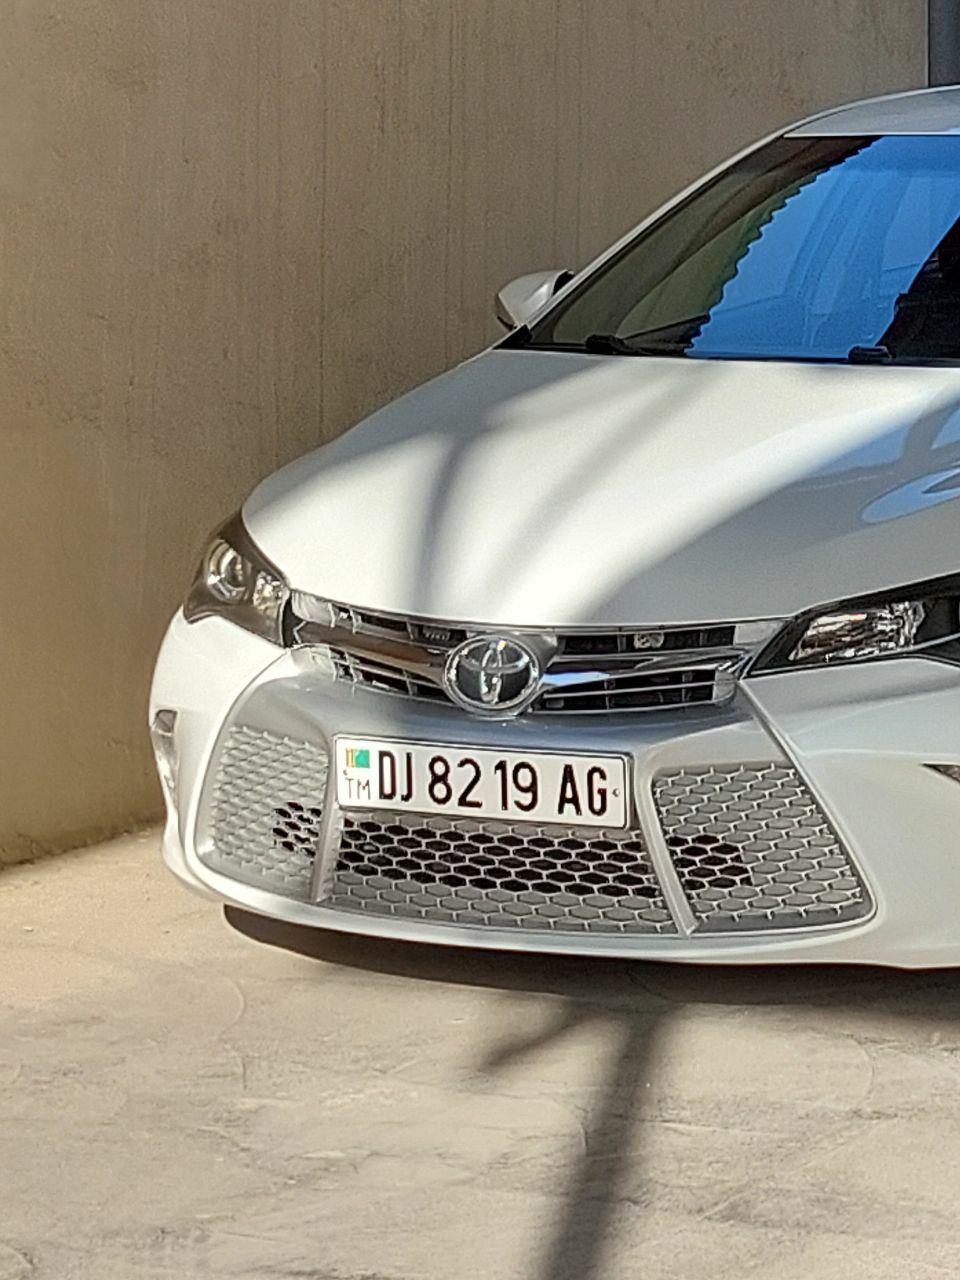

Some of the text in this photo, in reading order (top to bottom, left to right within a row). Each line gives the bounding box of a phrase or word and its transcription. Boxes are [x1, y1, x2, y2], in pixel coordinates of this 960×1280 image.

[345, 777, 371, 800] TM
[378, 750, 608, 817] DJ 8219 AG
